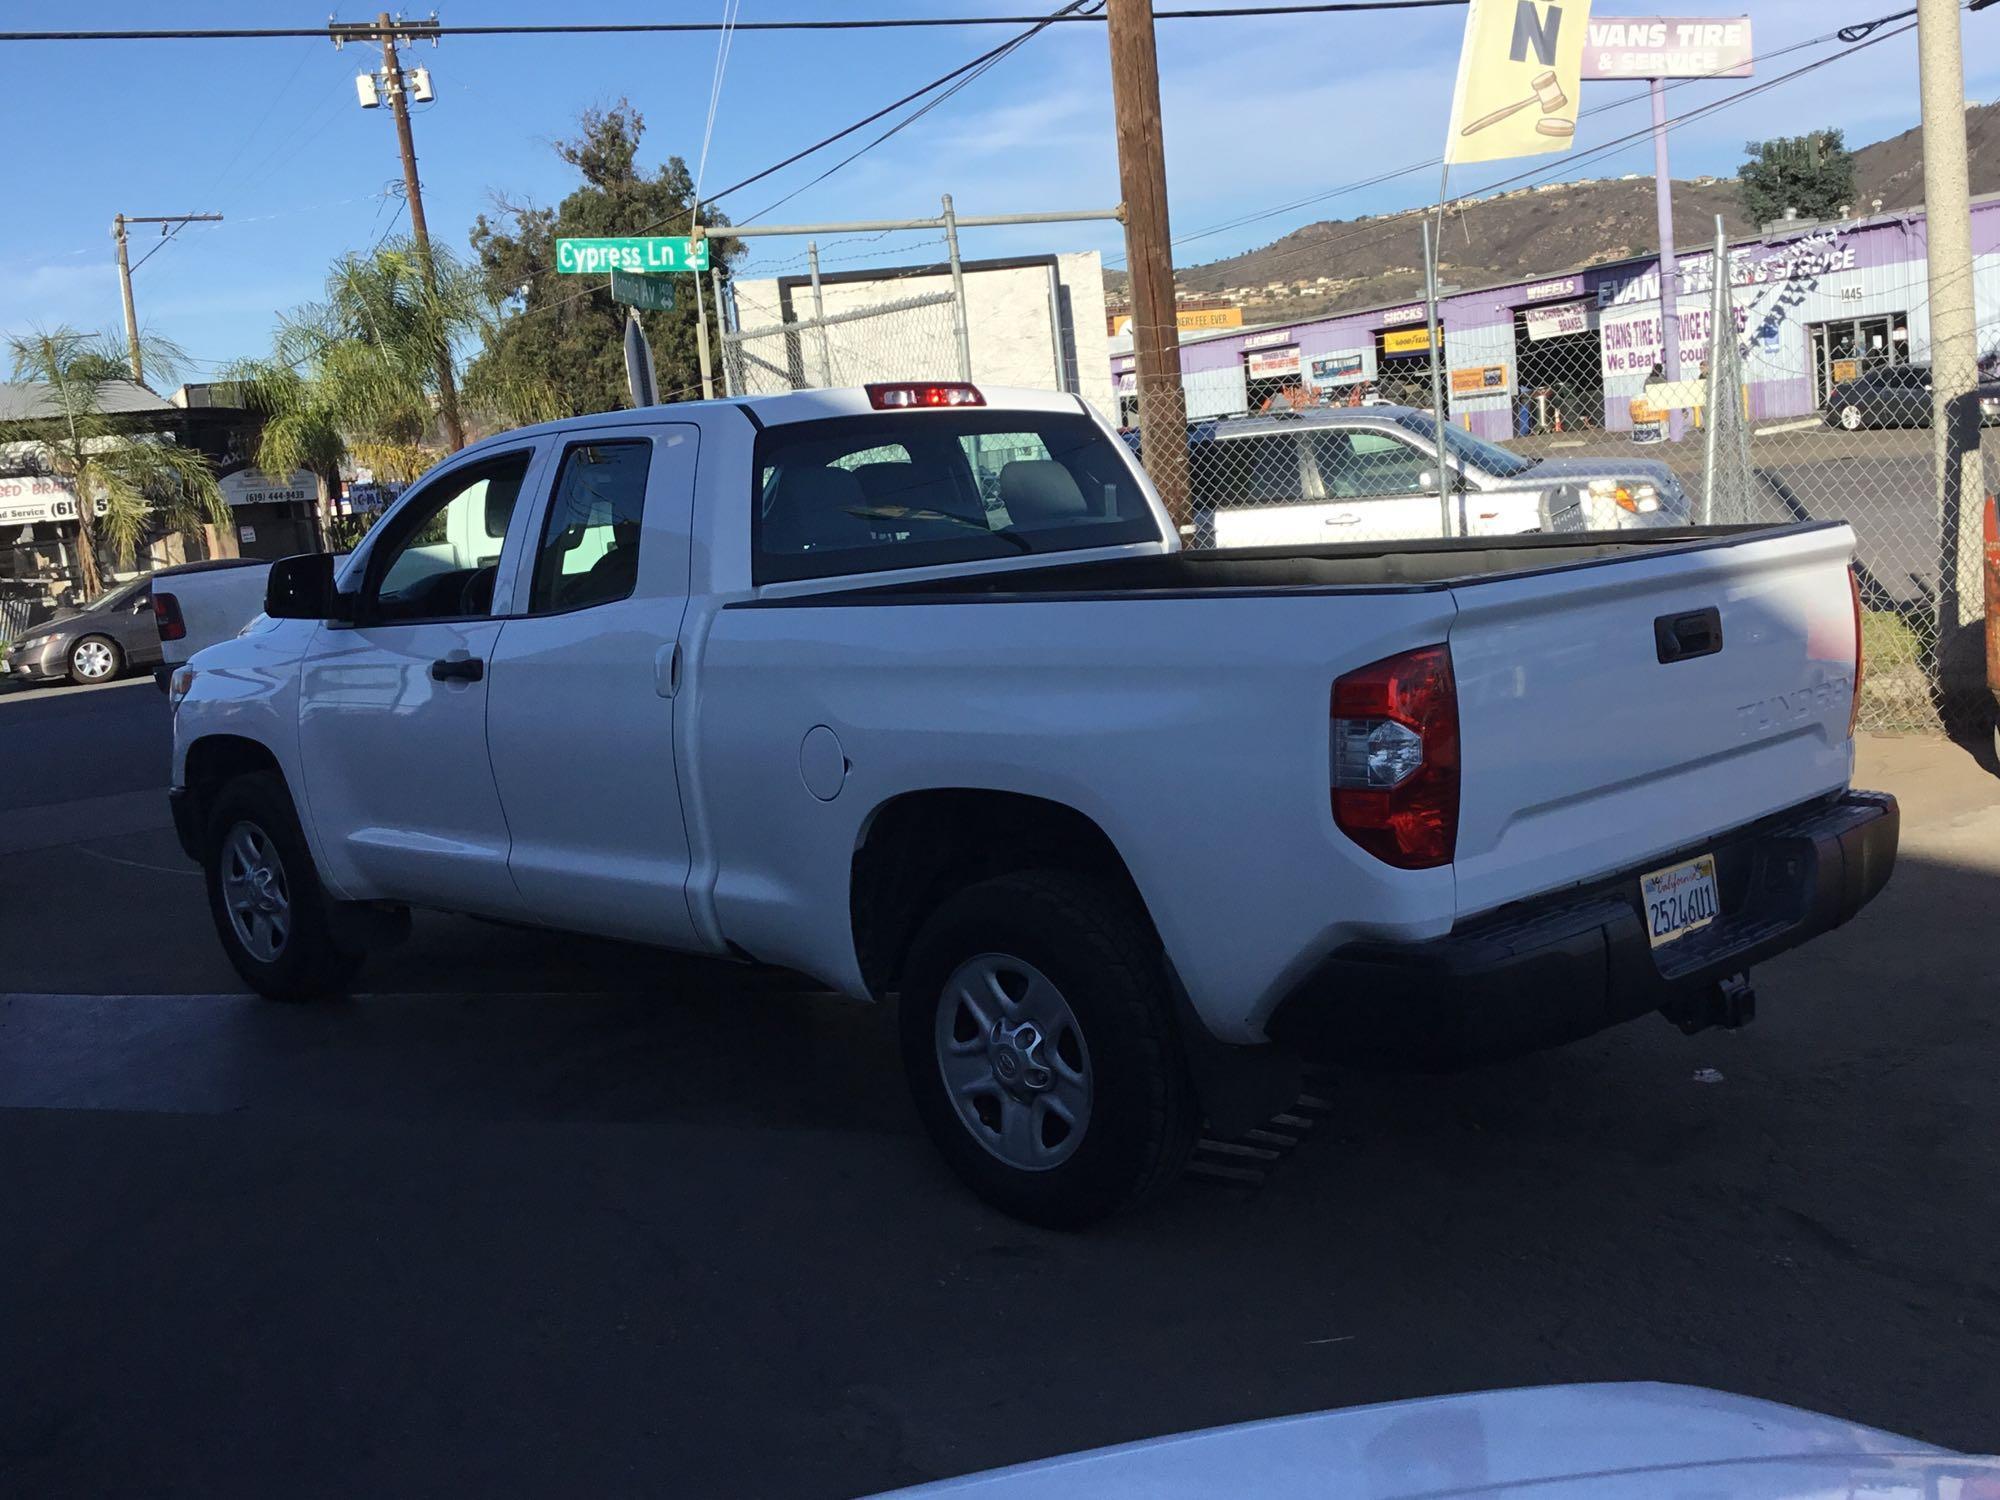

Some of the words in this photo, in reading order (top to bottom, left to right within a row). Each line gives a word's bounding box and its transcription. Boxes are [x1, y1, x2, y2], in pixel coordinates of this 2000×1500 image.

[1508, 0, 1563, 67] N
[1584, 24, 1668, 48] VANS
[1676, 24, 1743, 47] TIRE
[1598, 52, 1614, 71] &
[1621, 52, 1720, 71] SERVICE
[560, 242, 641, 273] Cypress
[648, 241, 674, 266] Ln
[1526, 281, 1574, 300] WHEELS
[1598, 272, 1661, 307] EVAN
[1841, 287, 1862, 300] 1445
[1195, 315, 1207, 326] FEE
[1210, 314, 1227, 325] EVER
[1383, 307, 1423, 324] SHOCKS
[1558, 316, 1583, 332] BRAKES
[1604, 322, 1632, 350] EVANS
[1633, 319, 1653, 346] TIRE
[1607, 353, 1625, 370] We
[1628, 350, 1656, 369] Beat
[11, 508, 45, 518] Service
